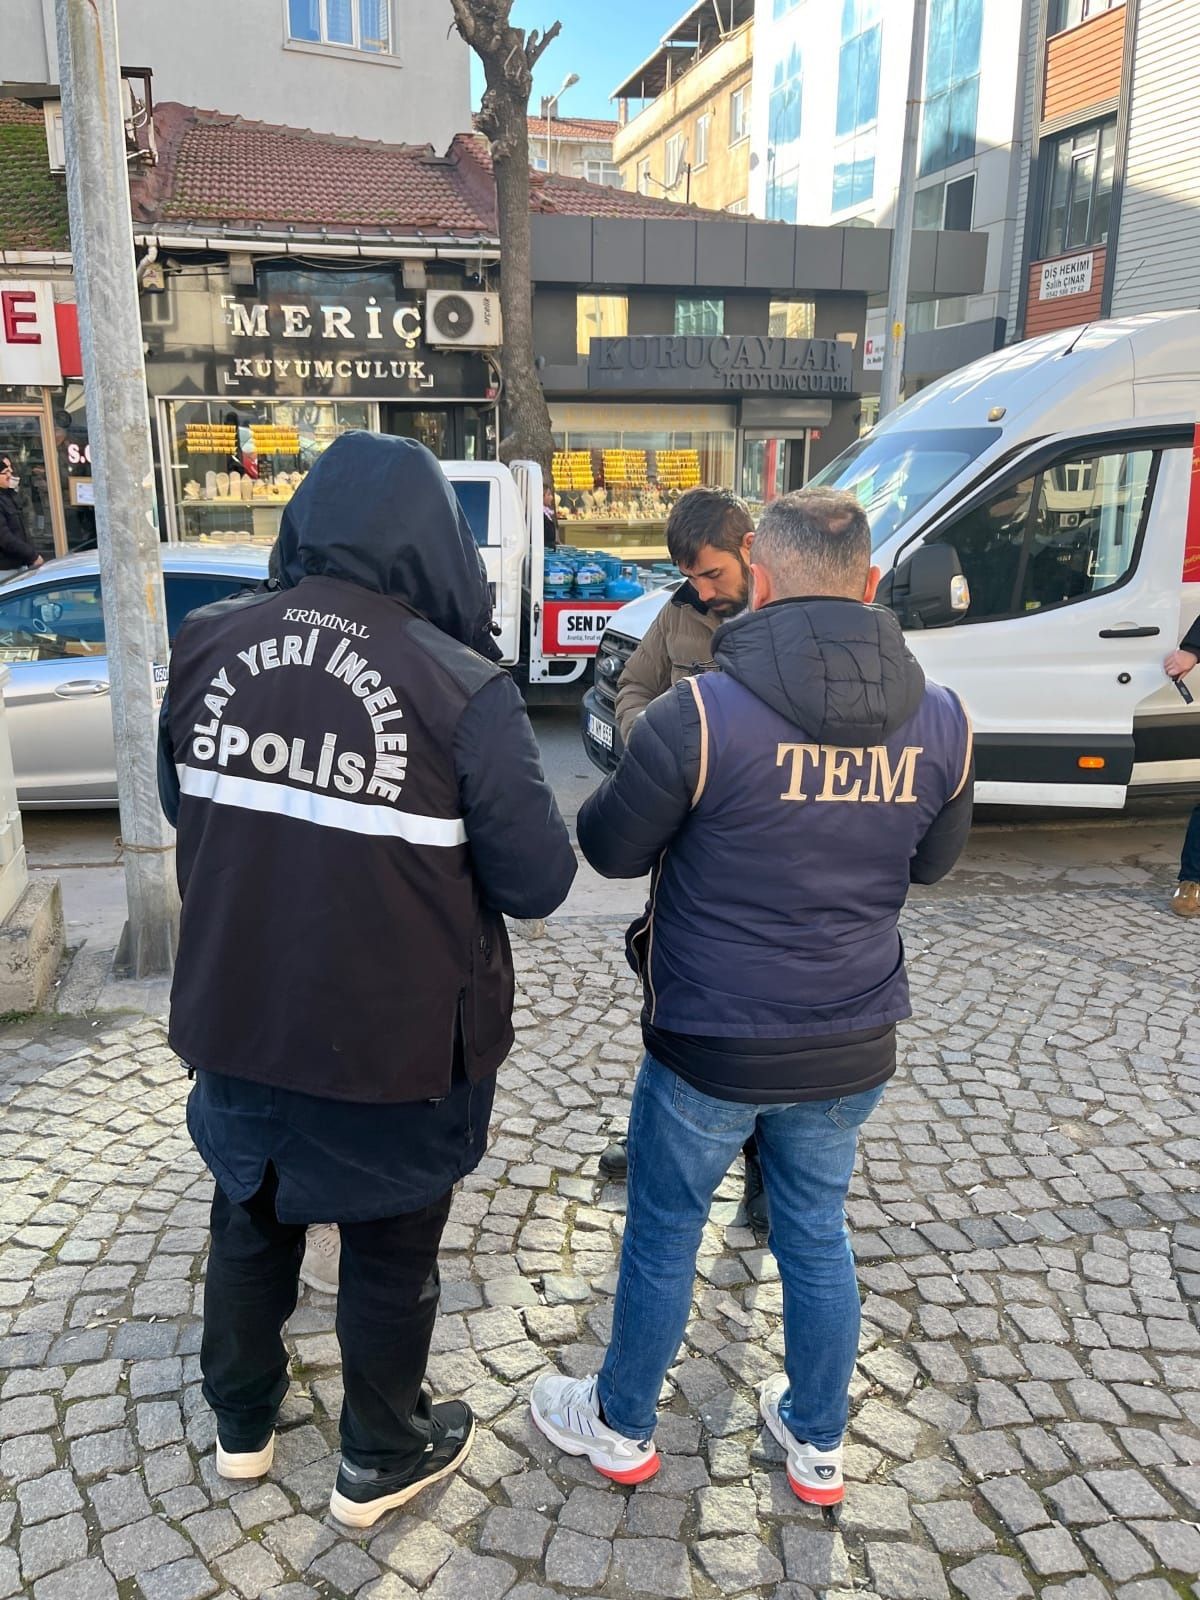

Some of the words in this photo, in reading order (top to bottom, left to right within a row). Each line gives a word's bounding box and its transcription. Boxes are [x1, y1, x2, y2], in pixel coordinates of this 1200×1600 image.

[1044, 265, 1057, 280] DİŞ
[1060, 256, 1090, 275] HEKİMİ
[1046, 279, 1062, 290] Salih
[1064, 273, 1085, 288] ÇINAR
[1, 291, 42, 344] E
[230, 297, 423, 348] MERİÇ
[234, 359, 426, 379] KUYUMCULUK
[598, 336, 841, 379] KURUÇAYLAR
[723, 373, 848, 392] KUYUMCULUK
[283, 608, 370, 639] KRİMİNAL
[567, 615, 593, 631] SEN
[193, 667, 236, 760] OLAY
[237, 628, 320, 676] YERİ
[325, 637, 408, 802] İNCELEME
[217, 724, 366, 794] POLİS
[776, 742, 924, 803] TEM
